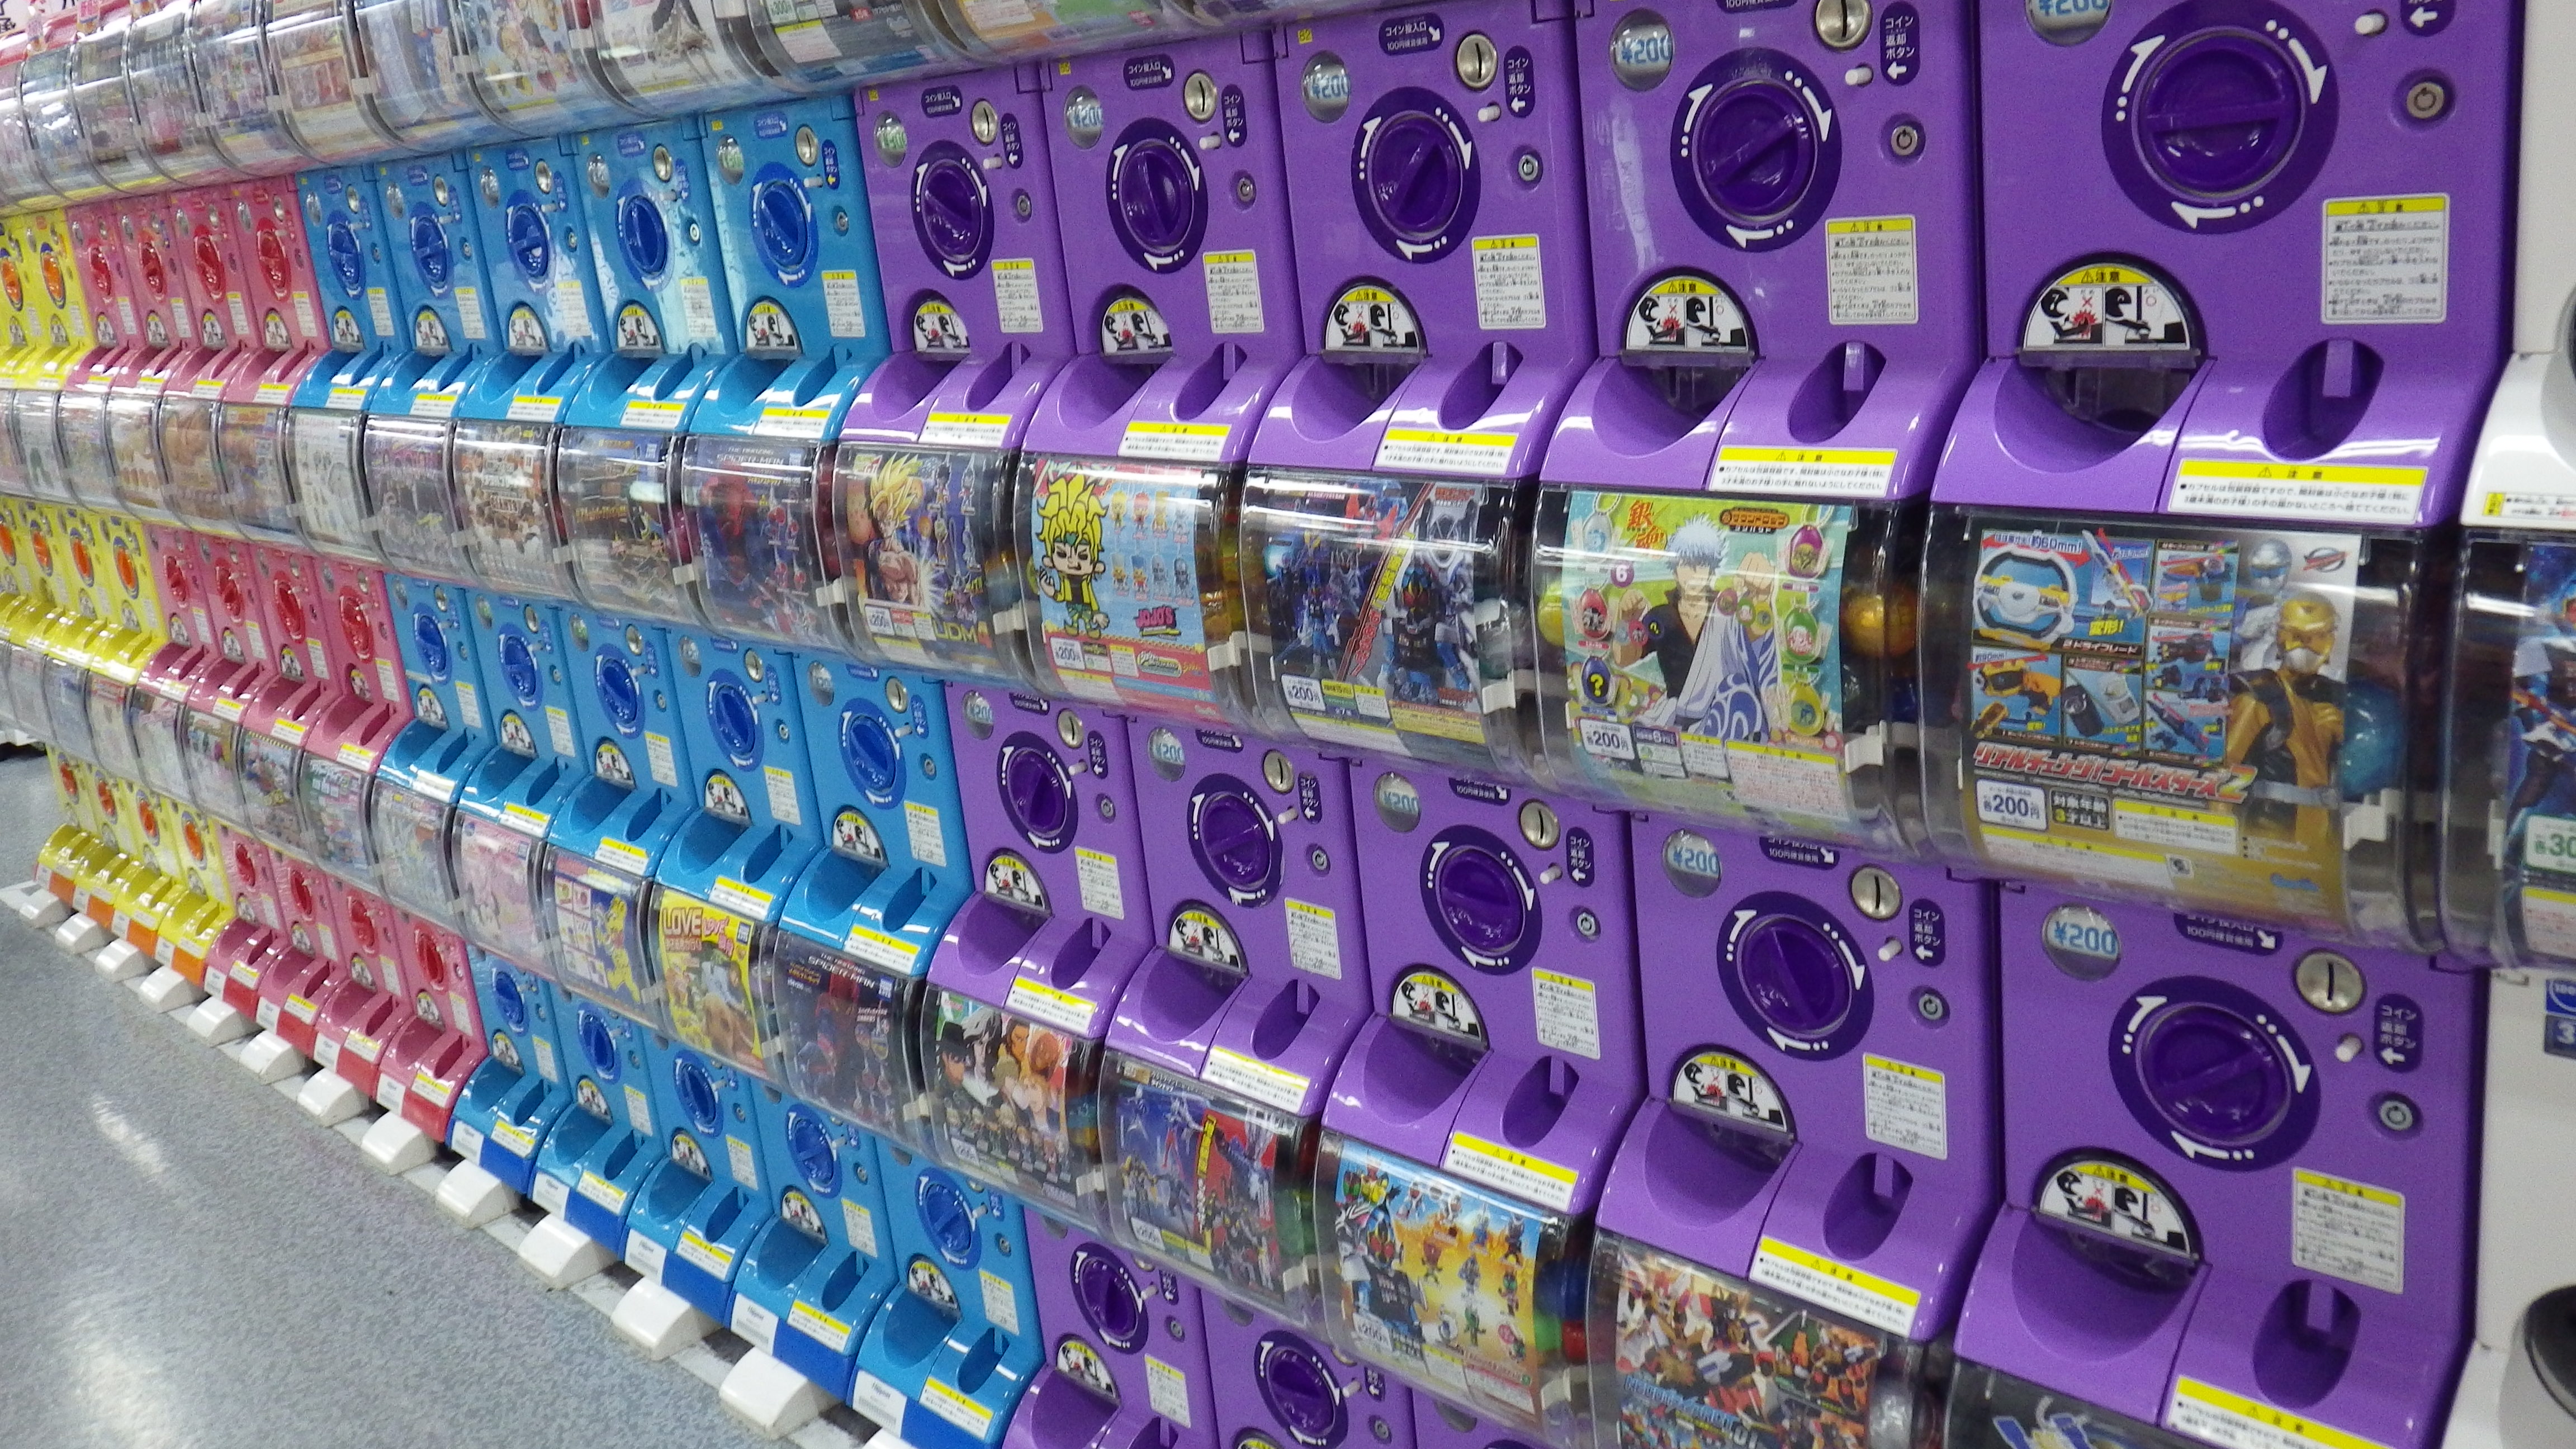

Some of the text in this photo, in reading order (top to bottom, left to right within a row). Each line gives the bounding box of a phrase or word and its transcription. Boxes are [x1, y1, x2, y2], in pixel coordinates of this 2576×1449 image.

[1886, 16, 1914, 29] コイン
[1622, 35, 1671, 64] ¥200
[1886, 46, 1915, 60] ボタン
[1507, 57, 1529, 69] コイン
[1311, 74, 1351, 100] ¥200
[1509, 84, 1531, 96] ボタン
[1570, 836, 1590, 847] コイン
[1570, 857, 1592, 870] ボタン
[1673, 846, 1720, 874] ¥200
[662, 907, 703, 937] LOVE
[1914, 908, 1940, 922] コイン
[1914, 932, 1940, 946] ボタン
[2054, 921, 2118, 956] ¥200
[2381, 1005, 2417, 1020] コイン
